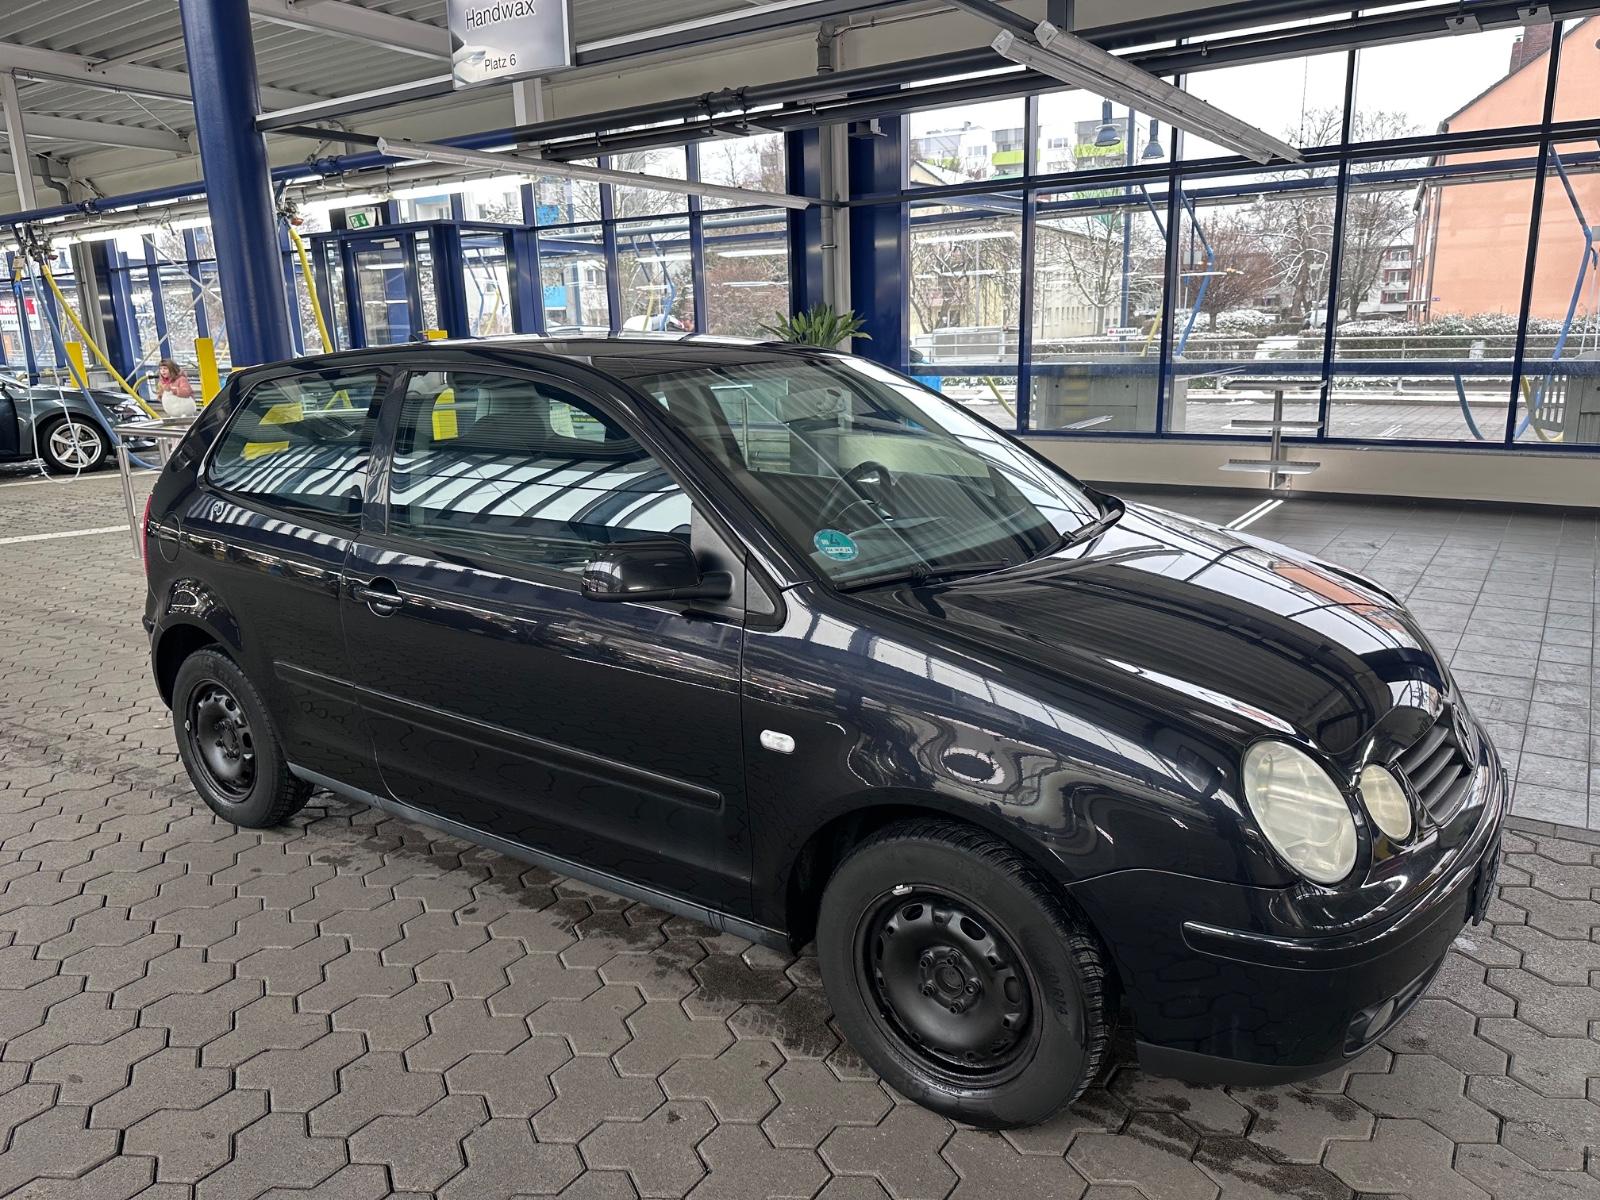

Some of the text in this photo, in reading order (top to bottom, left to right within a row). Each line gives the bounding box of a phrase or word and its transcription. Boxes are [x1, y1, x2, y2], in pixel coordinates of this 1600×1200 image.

[465, 0, 535, 30] Handwax
[484, 53, 517, 72] Platz 6
